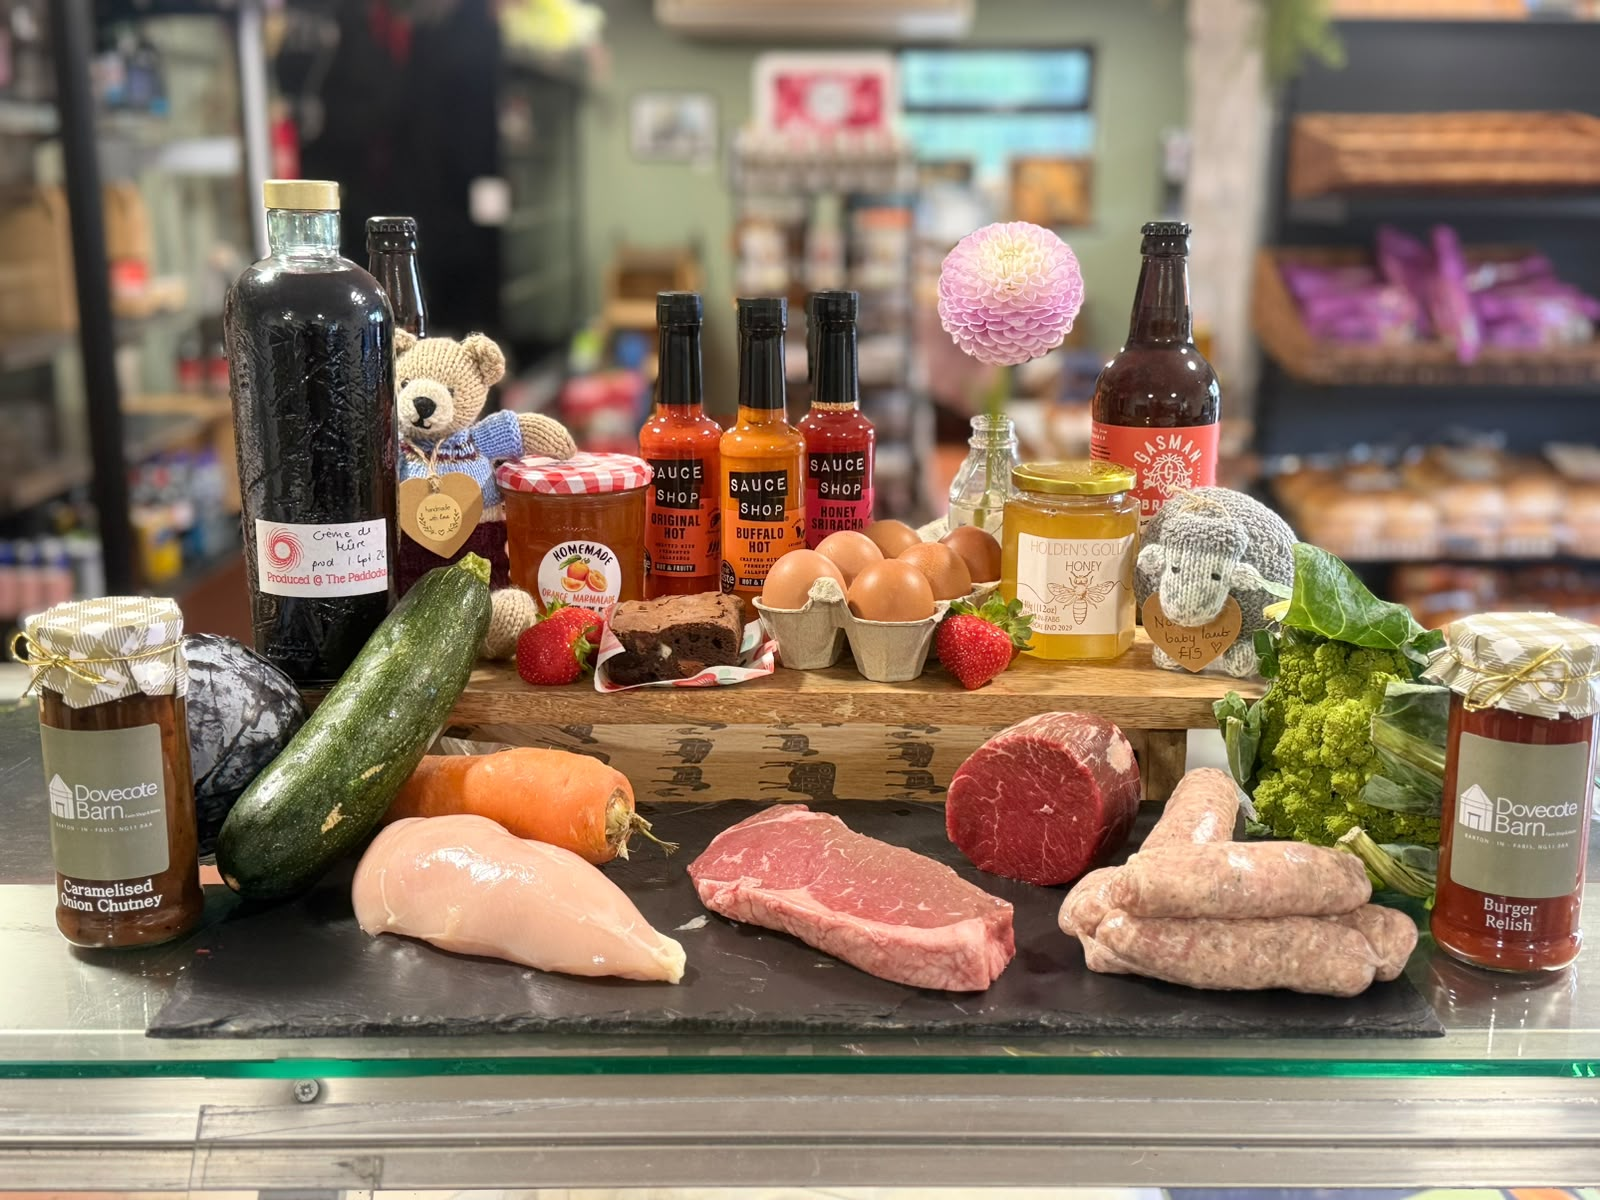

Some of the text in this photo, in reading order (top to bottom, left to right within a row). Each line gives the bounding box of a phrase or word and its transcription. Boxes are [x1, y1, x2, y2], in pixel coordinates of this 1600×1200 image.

[1134, 434, 1202, 465] GASMAN
[810, 458, 864, 473] SAUCE
[730, 477, 786, 492] SAUCE
[820, 482, 861, 495] SHOP
[657, 489, 698, 503] SHOP
[740, 502, 783, 516] SHOP
[820, 506, 856, 518] HONEY
[651, 512, 701, 527] ORIGINAL
[811, 518, 864, 530] SRIRACHA
[664, 527, 686, 539] HOT
[736, 527, 784, 539] BUFFALO
[749, 541, 771, 553] HOT
[1030, 541, 1125, 556] HOLDEN'S GOLD
[552, 544, 614, 566] HOMEMADE
[1065, 561, 1102, 571] HONEY
[267, 568, 388, 586] Produced @ The Paddocks
[542, 587, 615, 604] ORANGE MARMALADE
[1164, 632, 1195, 648] baby
[1178, 646, 1202, 660] £15
[74, 782, 158, 802] Dovecote
[76, 801, 124, 820] Barn
[1496, 796, 1578, 818] Dovecote
[1495, 814, 1545, 836] Barn
[63, 878, 154, 898] Caramelised
[61, 892, 163, 913] Onion Chutney
[1483, 897, 1538, 918] Burger
[1485, 914, 1533, 932] Relish
